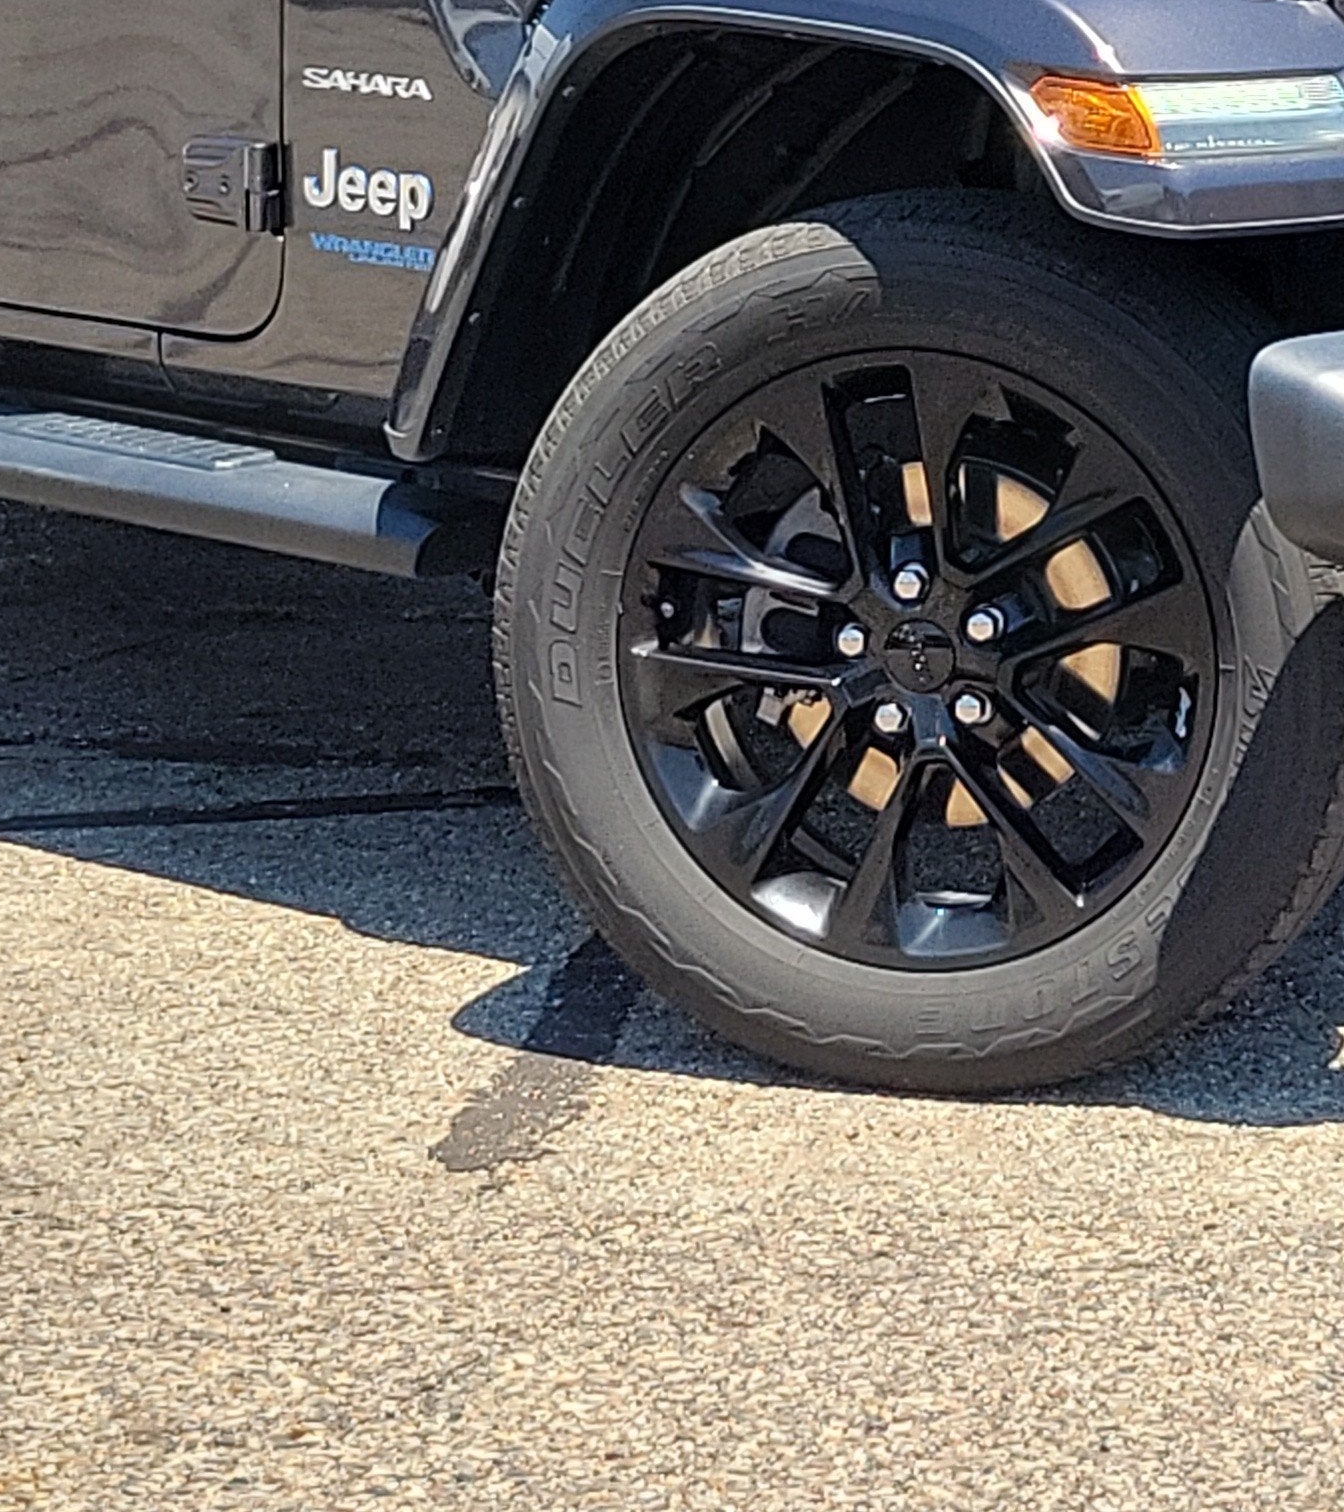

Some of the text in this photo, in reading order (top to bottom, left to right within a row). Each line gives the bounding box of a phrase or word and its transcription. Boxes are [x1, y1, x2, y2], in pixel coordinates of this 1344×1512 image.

[302, 65, 433, 101] SAHARA
[303, 146, 434, 231] Jeep
[548, 340, 722, 709] DUELER
